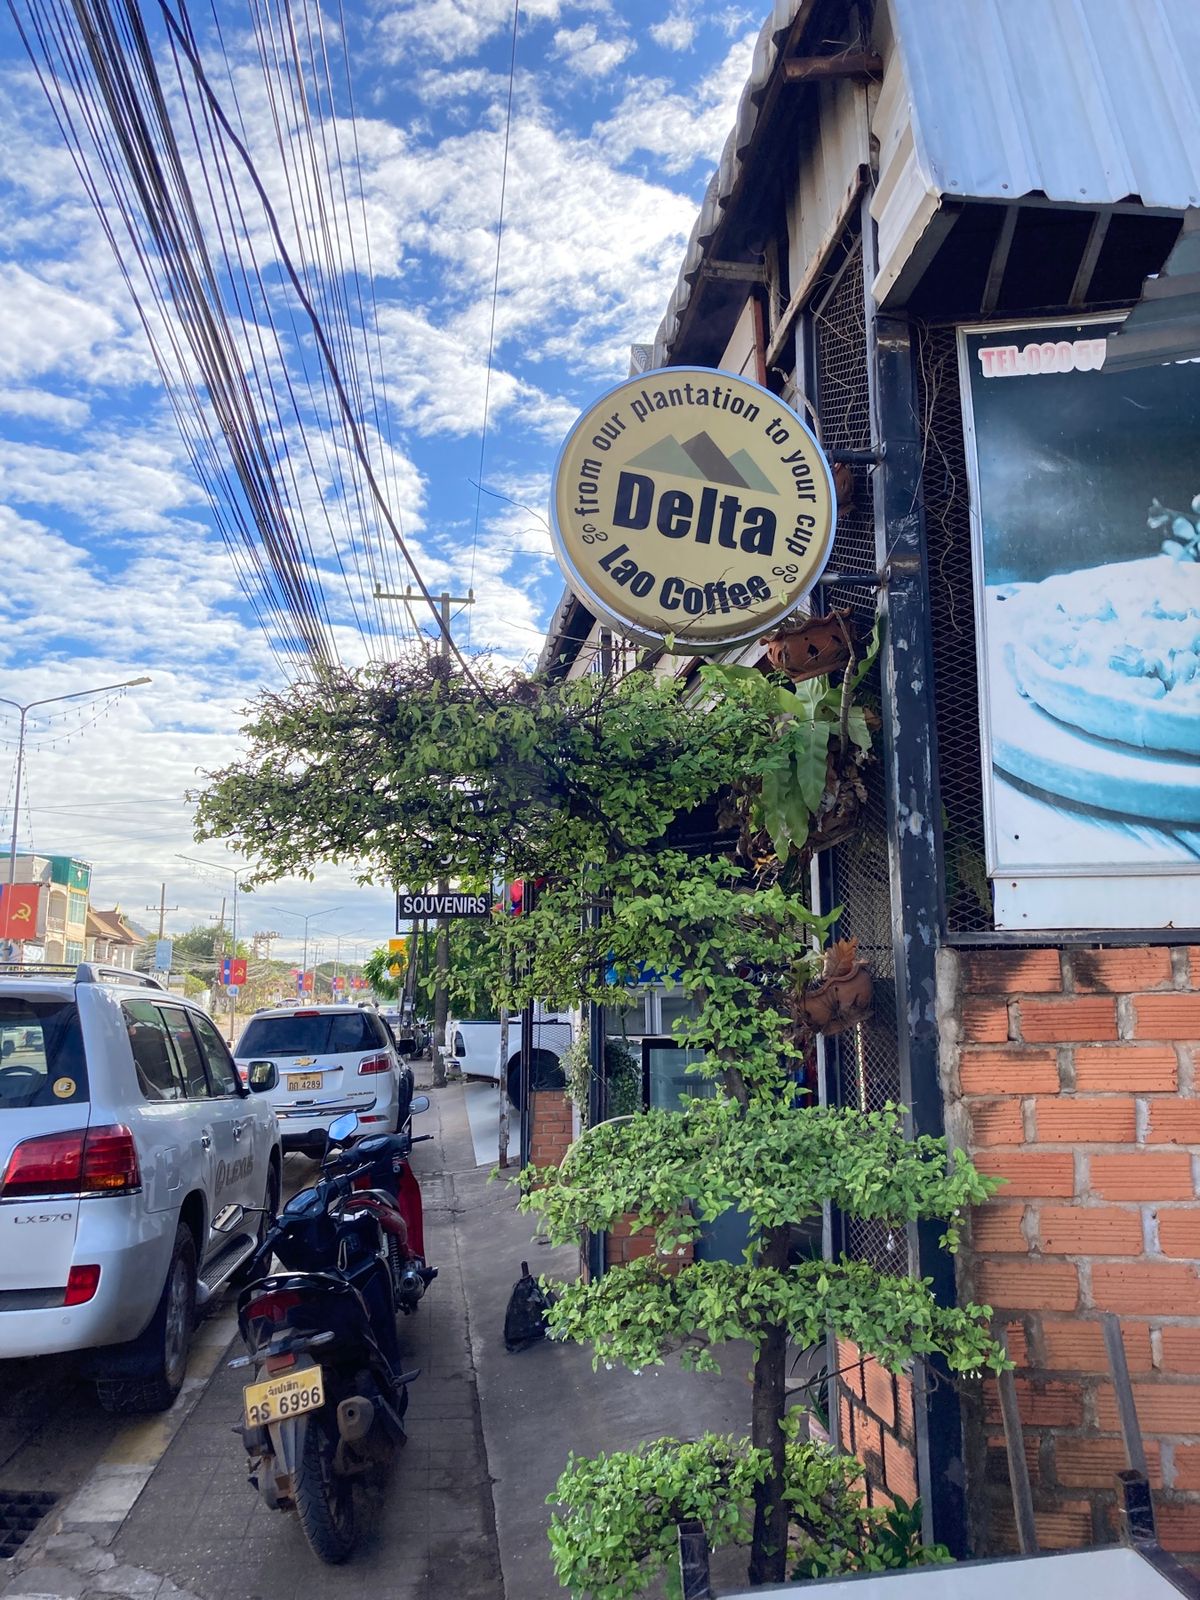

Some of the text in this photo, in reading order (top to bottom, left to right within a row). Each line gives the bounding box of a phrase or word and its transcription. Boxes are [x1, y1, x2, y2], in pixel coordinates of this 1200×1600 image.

[575, 383, 816, 557] from our plantation to your cup
[612, 471, 777, 556] Delta
[598, 543, 771, 615] Lao Coffee
[403, 896, 486, 914] SOUVENIRS
[302, 1080, 321, 1089] 4289
[279, 1386, 321, 1414] 6996
